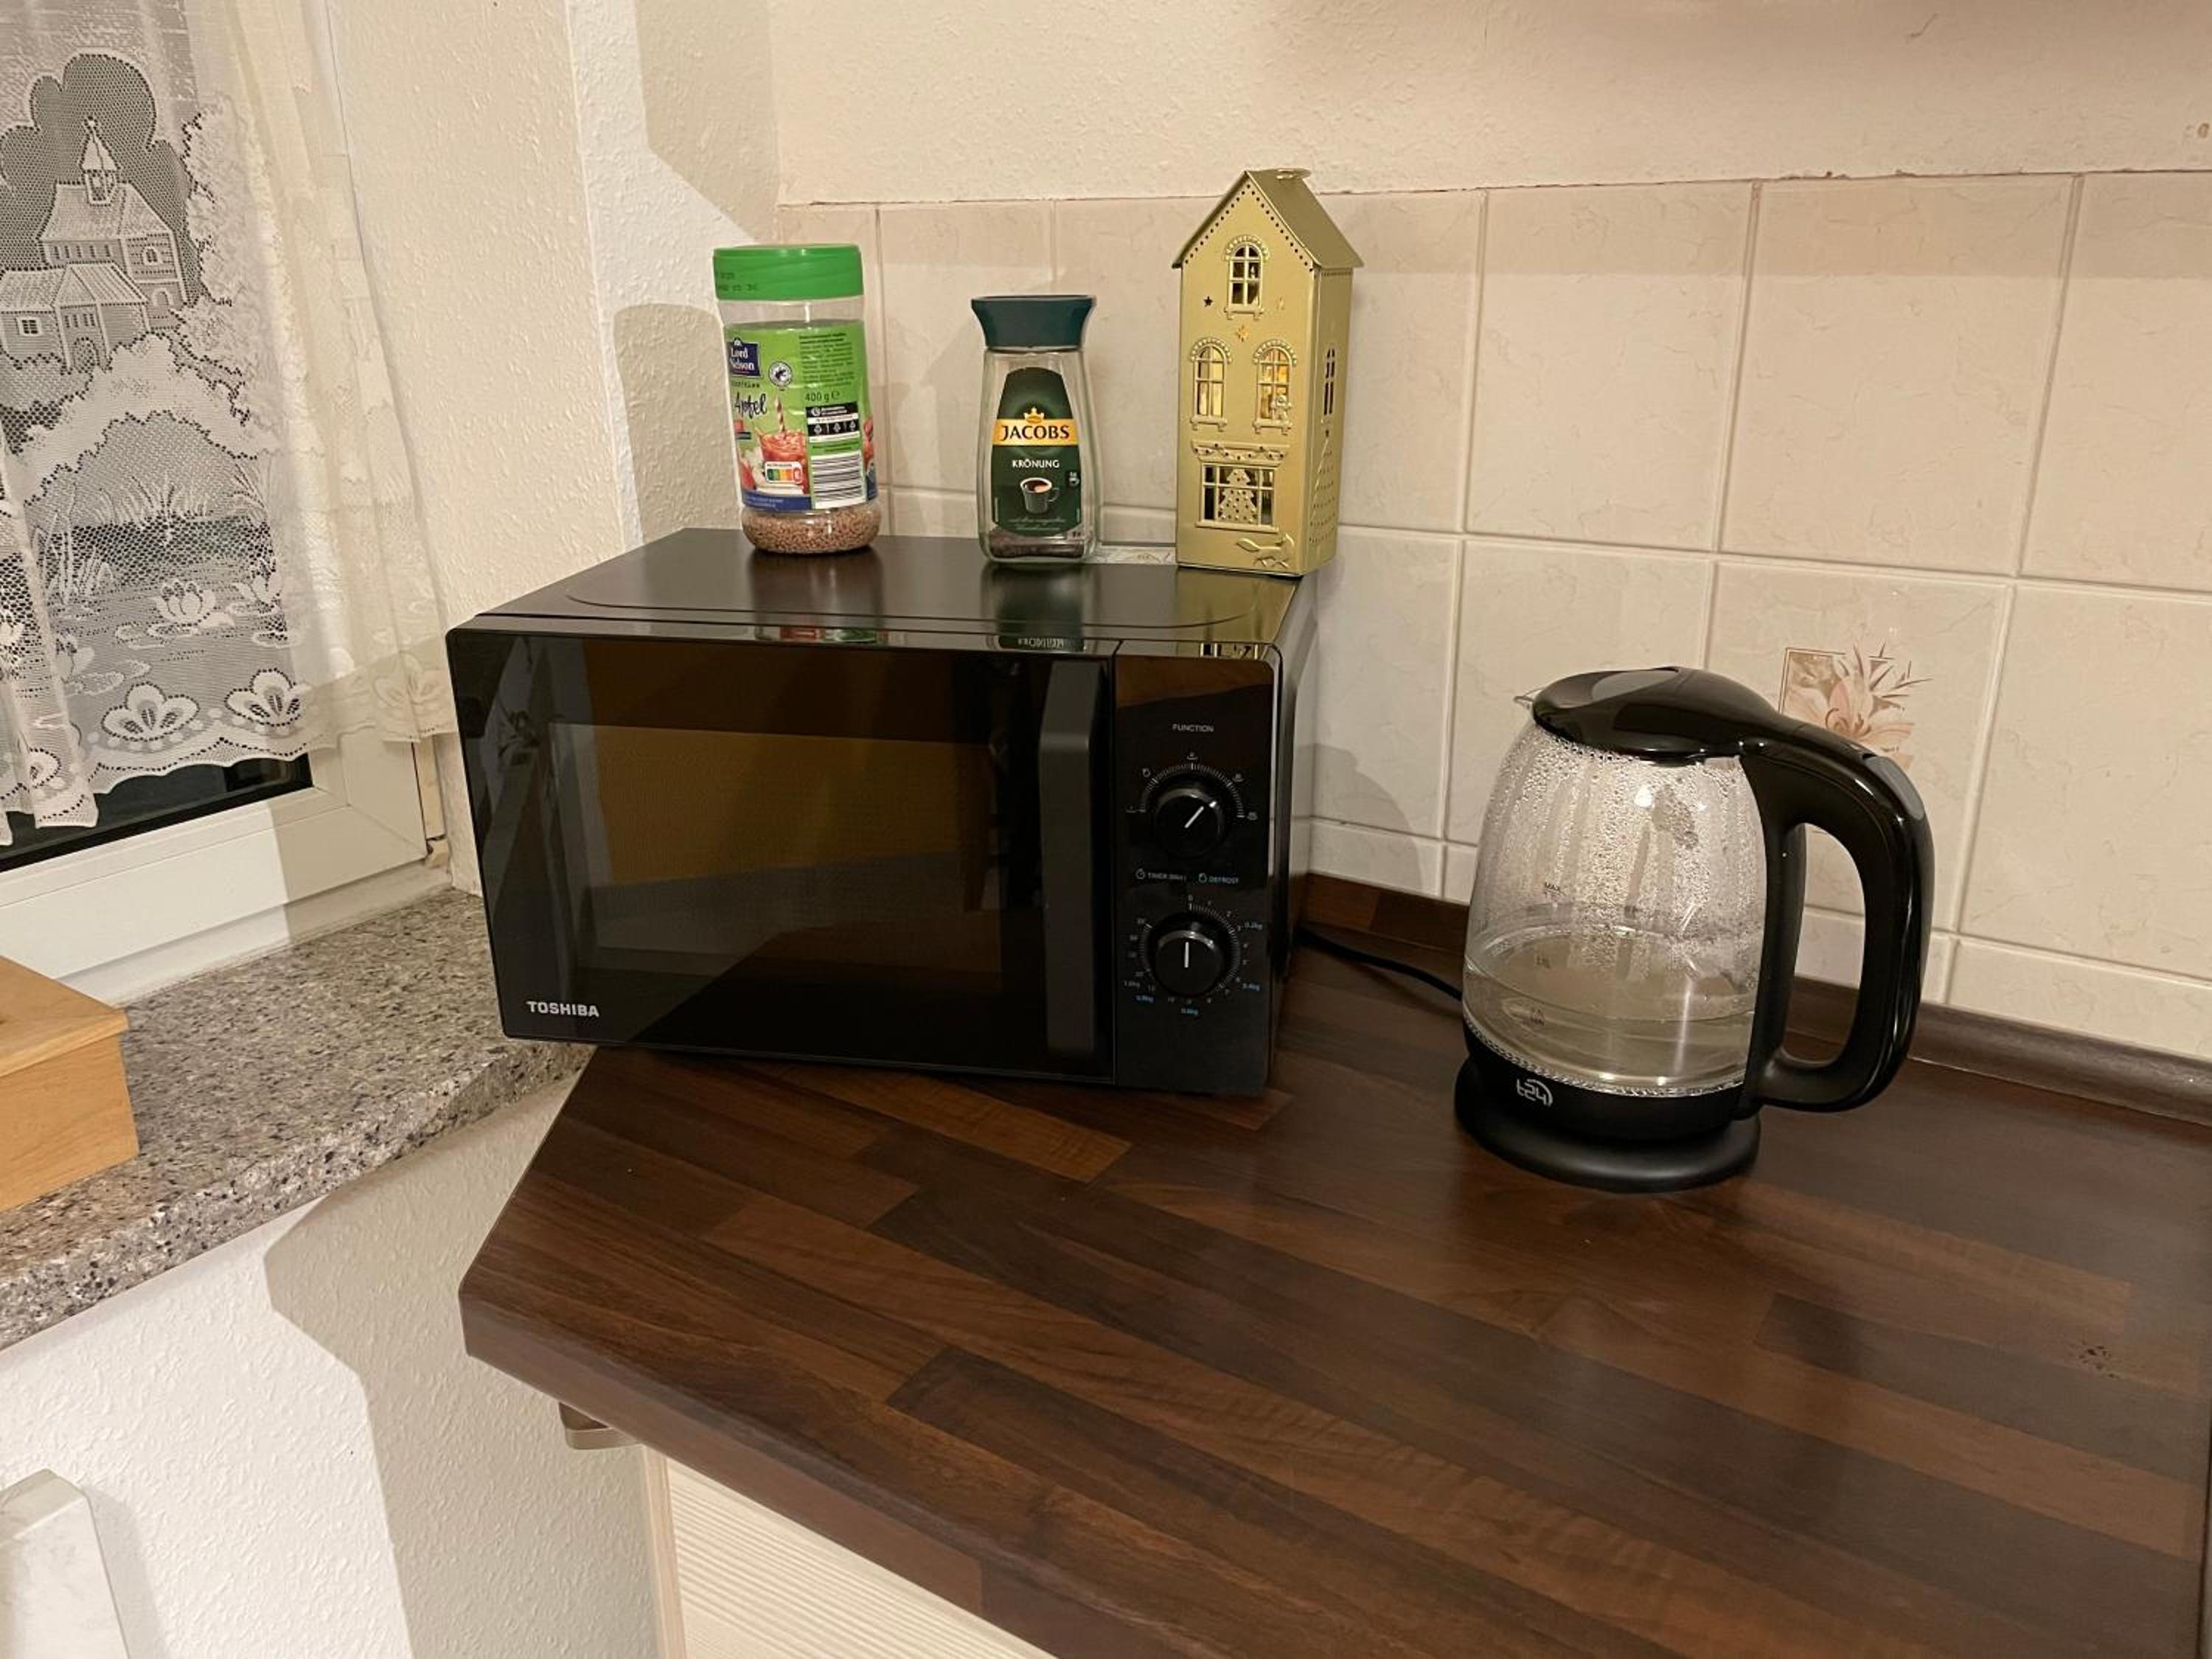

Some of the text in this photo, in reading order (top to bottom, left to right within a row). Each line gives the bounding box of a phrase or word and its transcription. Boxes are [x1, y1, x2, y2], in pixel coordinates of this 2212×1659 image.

[731, 347, 748, 359] Lord
[805, 392, 822, 402] 400
[1001, 425, 1070, 442] JACOBS
[1012, 458, 1060, 468] KRÖNUNG
[1172, 723, 1214, 733] FUNCTION
[526, 1001, 599, 1017] TOSHIBA
